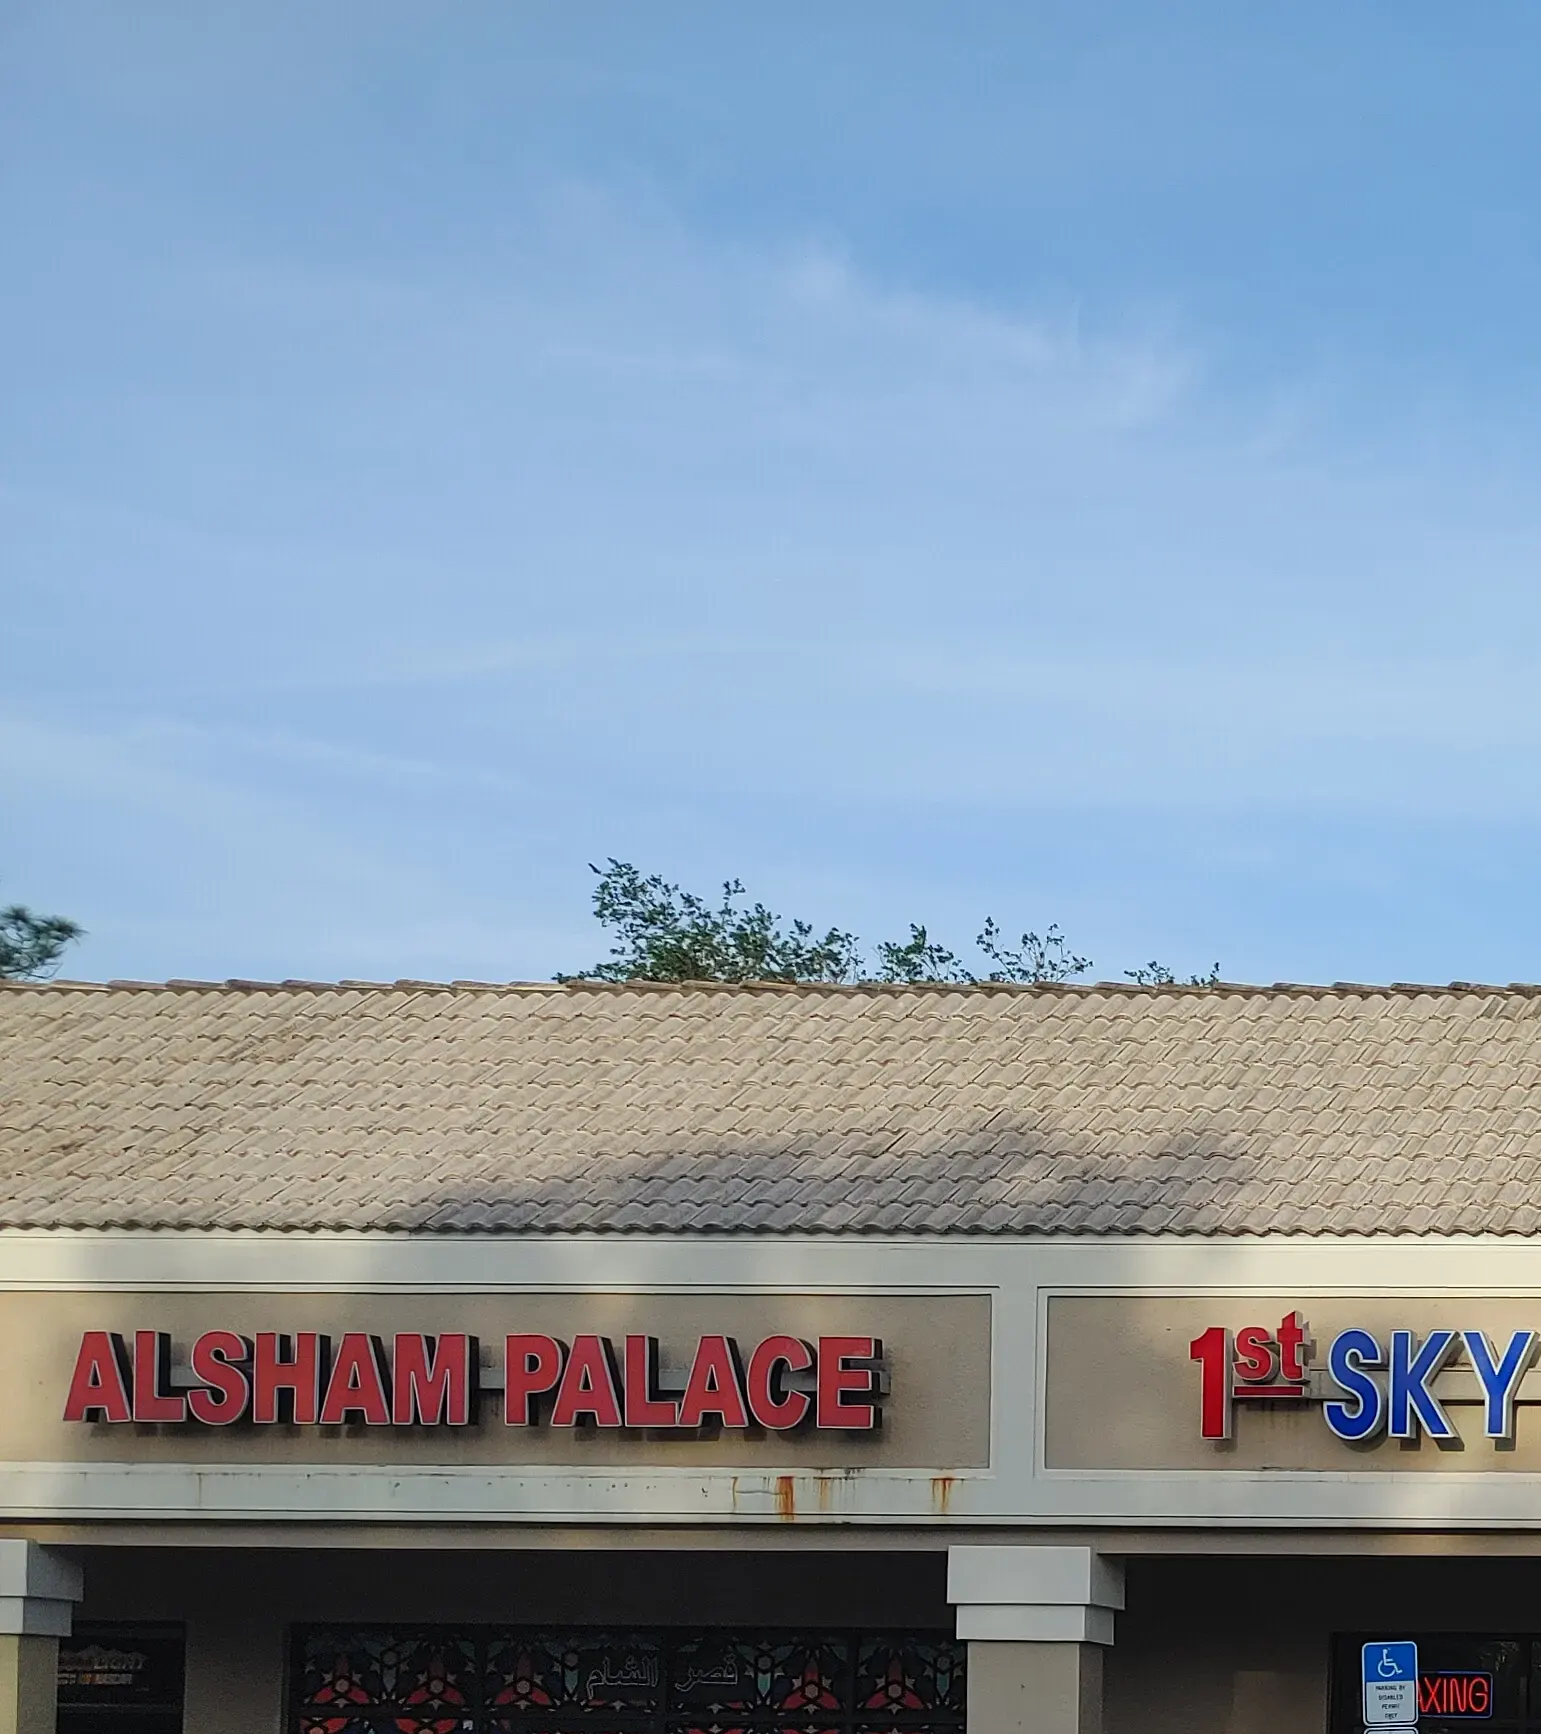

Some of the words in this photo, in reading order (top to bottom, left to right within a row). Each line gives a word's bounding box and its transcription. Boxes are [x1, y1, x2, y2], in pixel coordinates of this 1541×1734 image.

[63, 1330, 470, 1425] ALSHAM
[504, 1333, 876, 1430] PALACE
[1190, 1310, 1307, 1440] 1st
[1322, 1328, 1534, 1440] SKY
